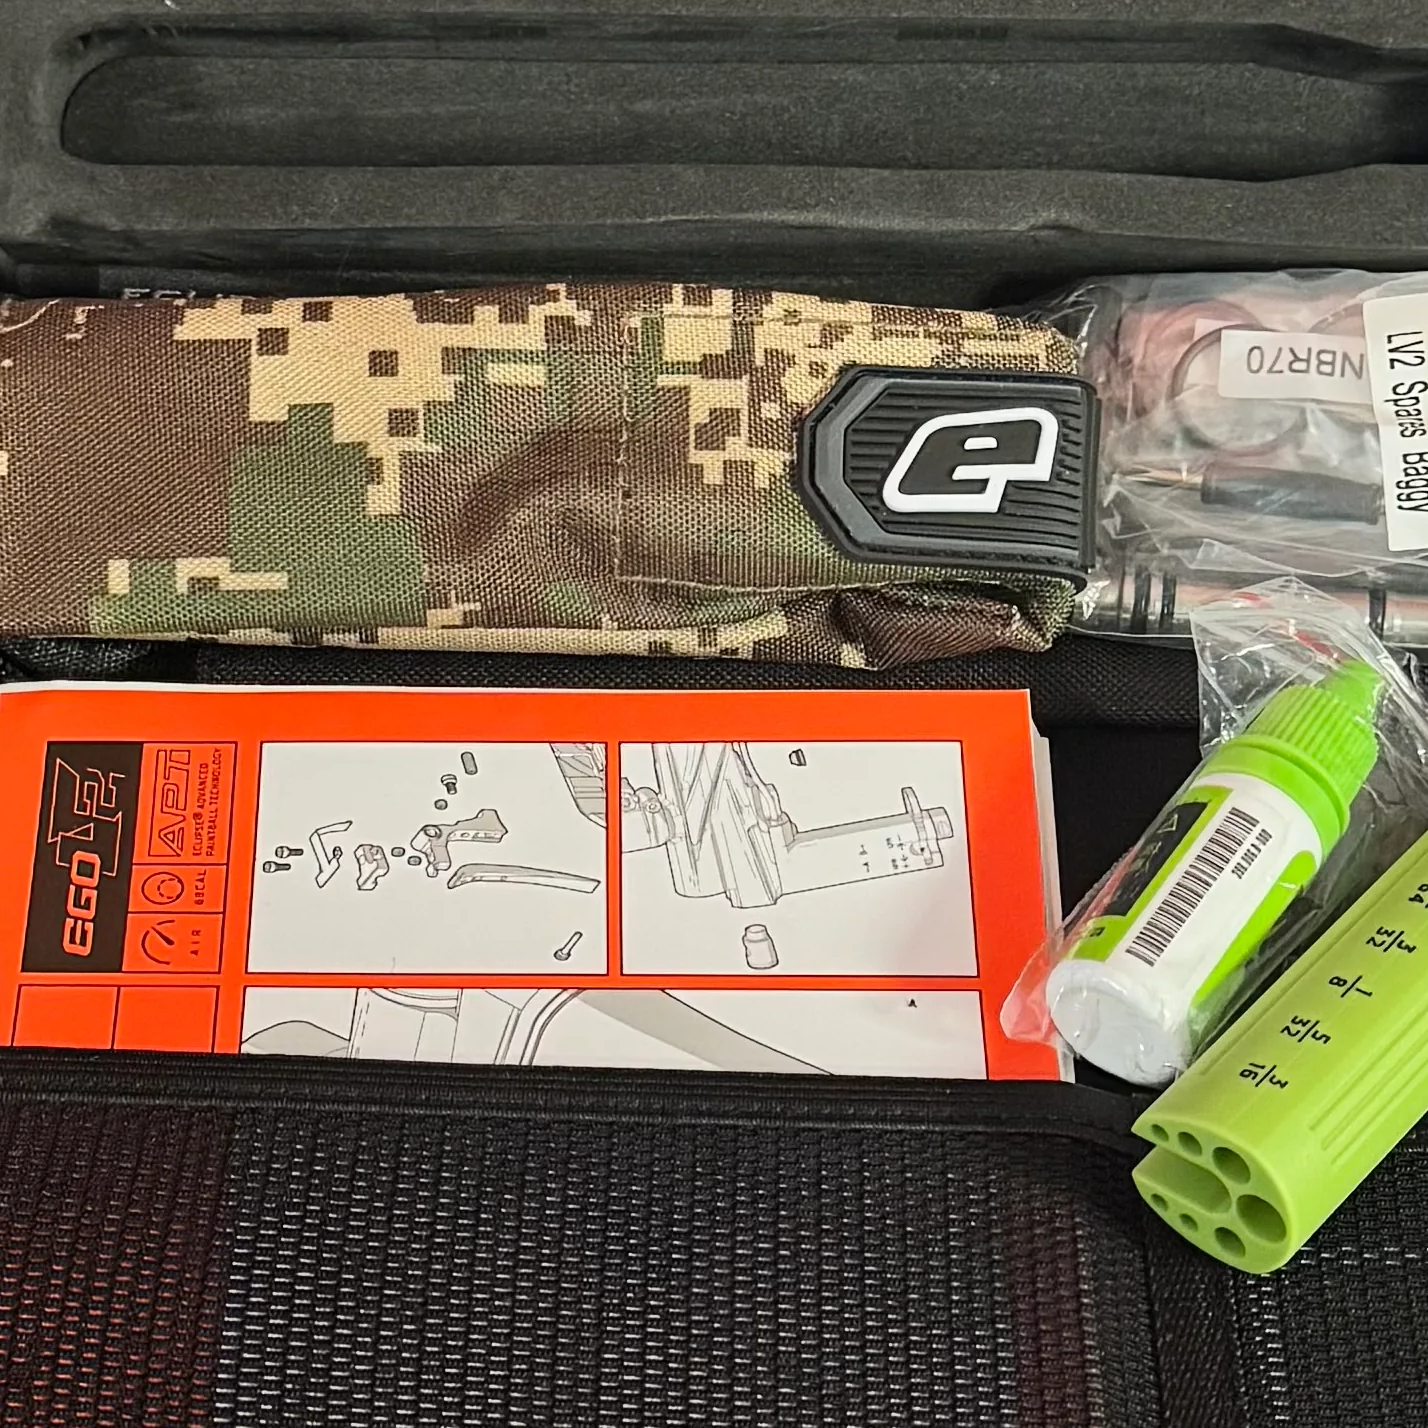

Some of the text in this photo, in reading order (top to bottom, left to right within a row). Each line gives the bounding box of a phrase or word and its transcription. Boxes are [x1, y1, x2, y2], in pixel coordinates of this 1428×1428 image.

[1246, 345, 1364, 380] NBR70
[1387, 331, 1426, 369] LV2
[1384, 380, 1428, 438] Spares
[62, 850, 101, 957] EGO
